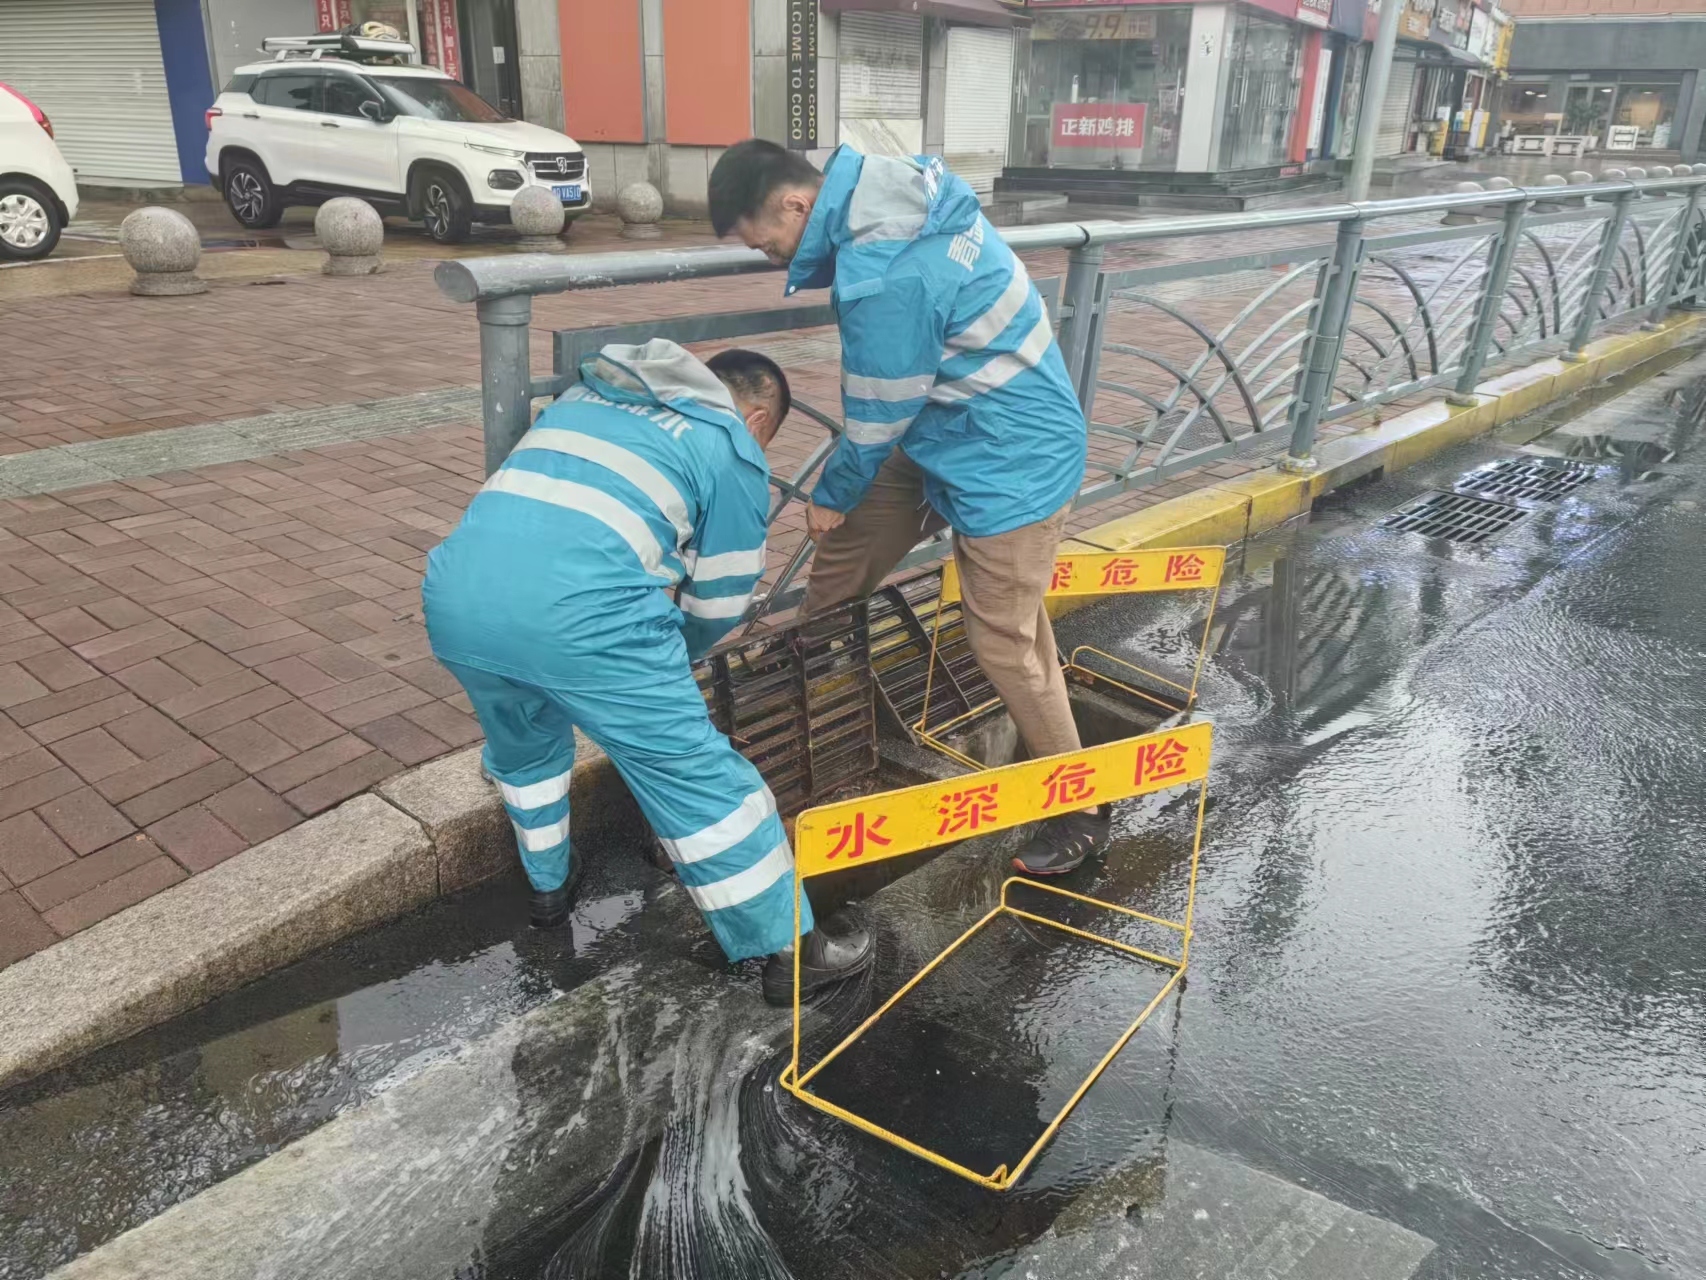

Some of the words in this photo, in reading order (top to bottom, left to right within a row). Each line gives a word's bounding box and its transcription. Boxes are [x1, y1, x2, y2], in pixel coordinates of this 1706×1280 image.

[791, 68, 802, 89] TO
[808, 68, 816, 89] TO
[791, 93, 802, 140] COCO
[808, 93, 816, 140] COCO
[1061, 116, 1135, 137] 正新鸡排
[826, 738, 1190, 860] 水深危险
